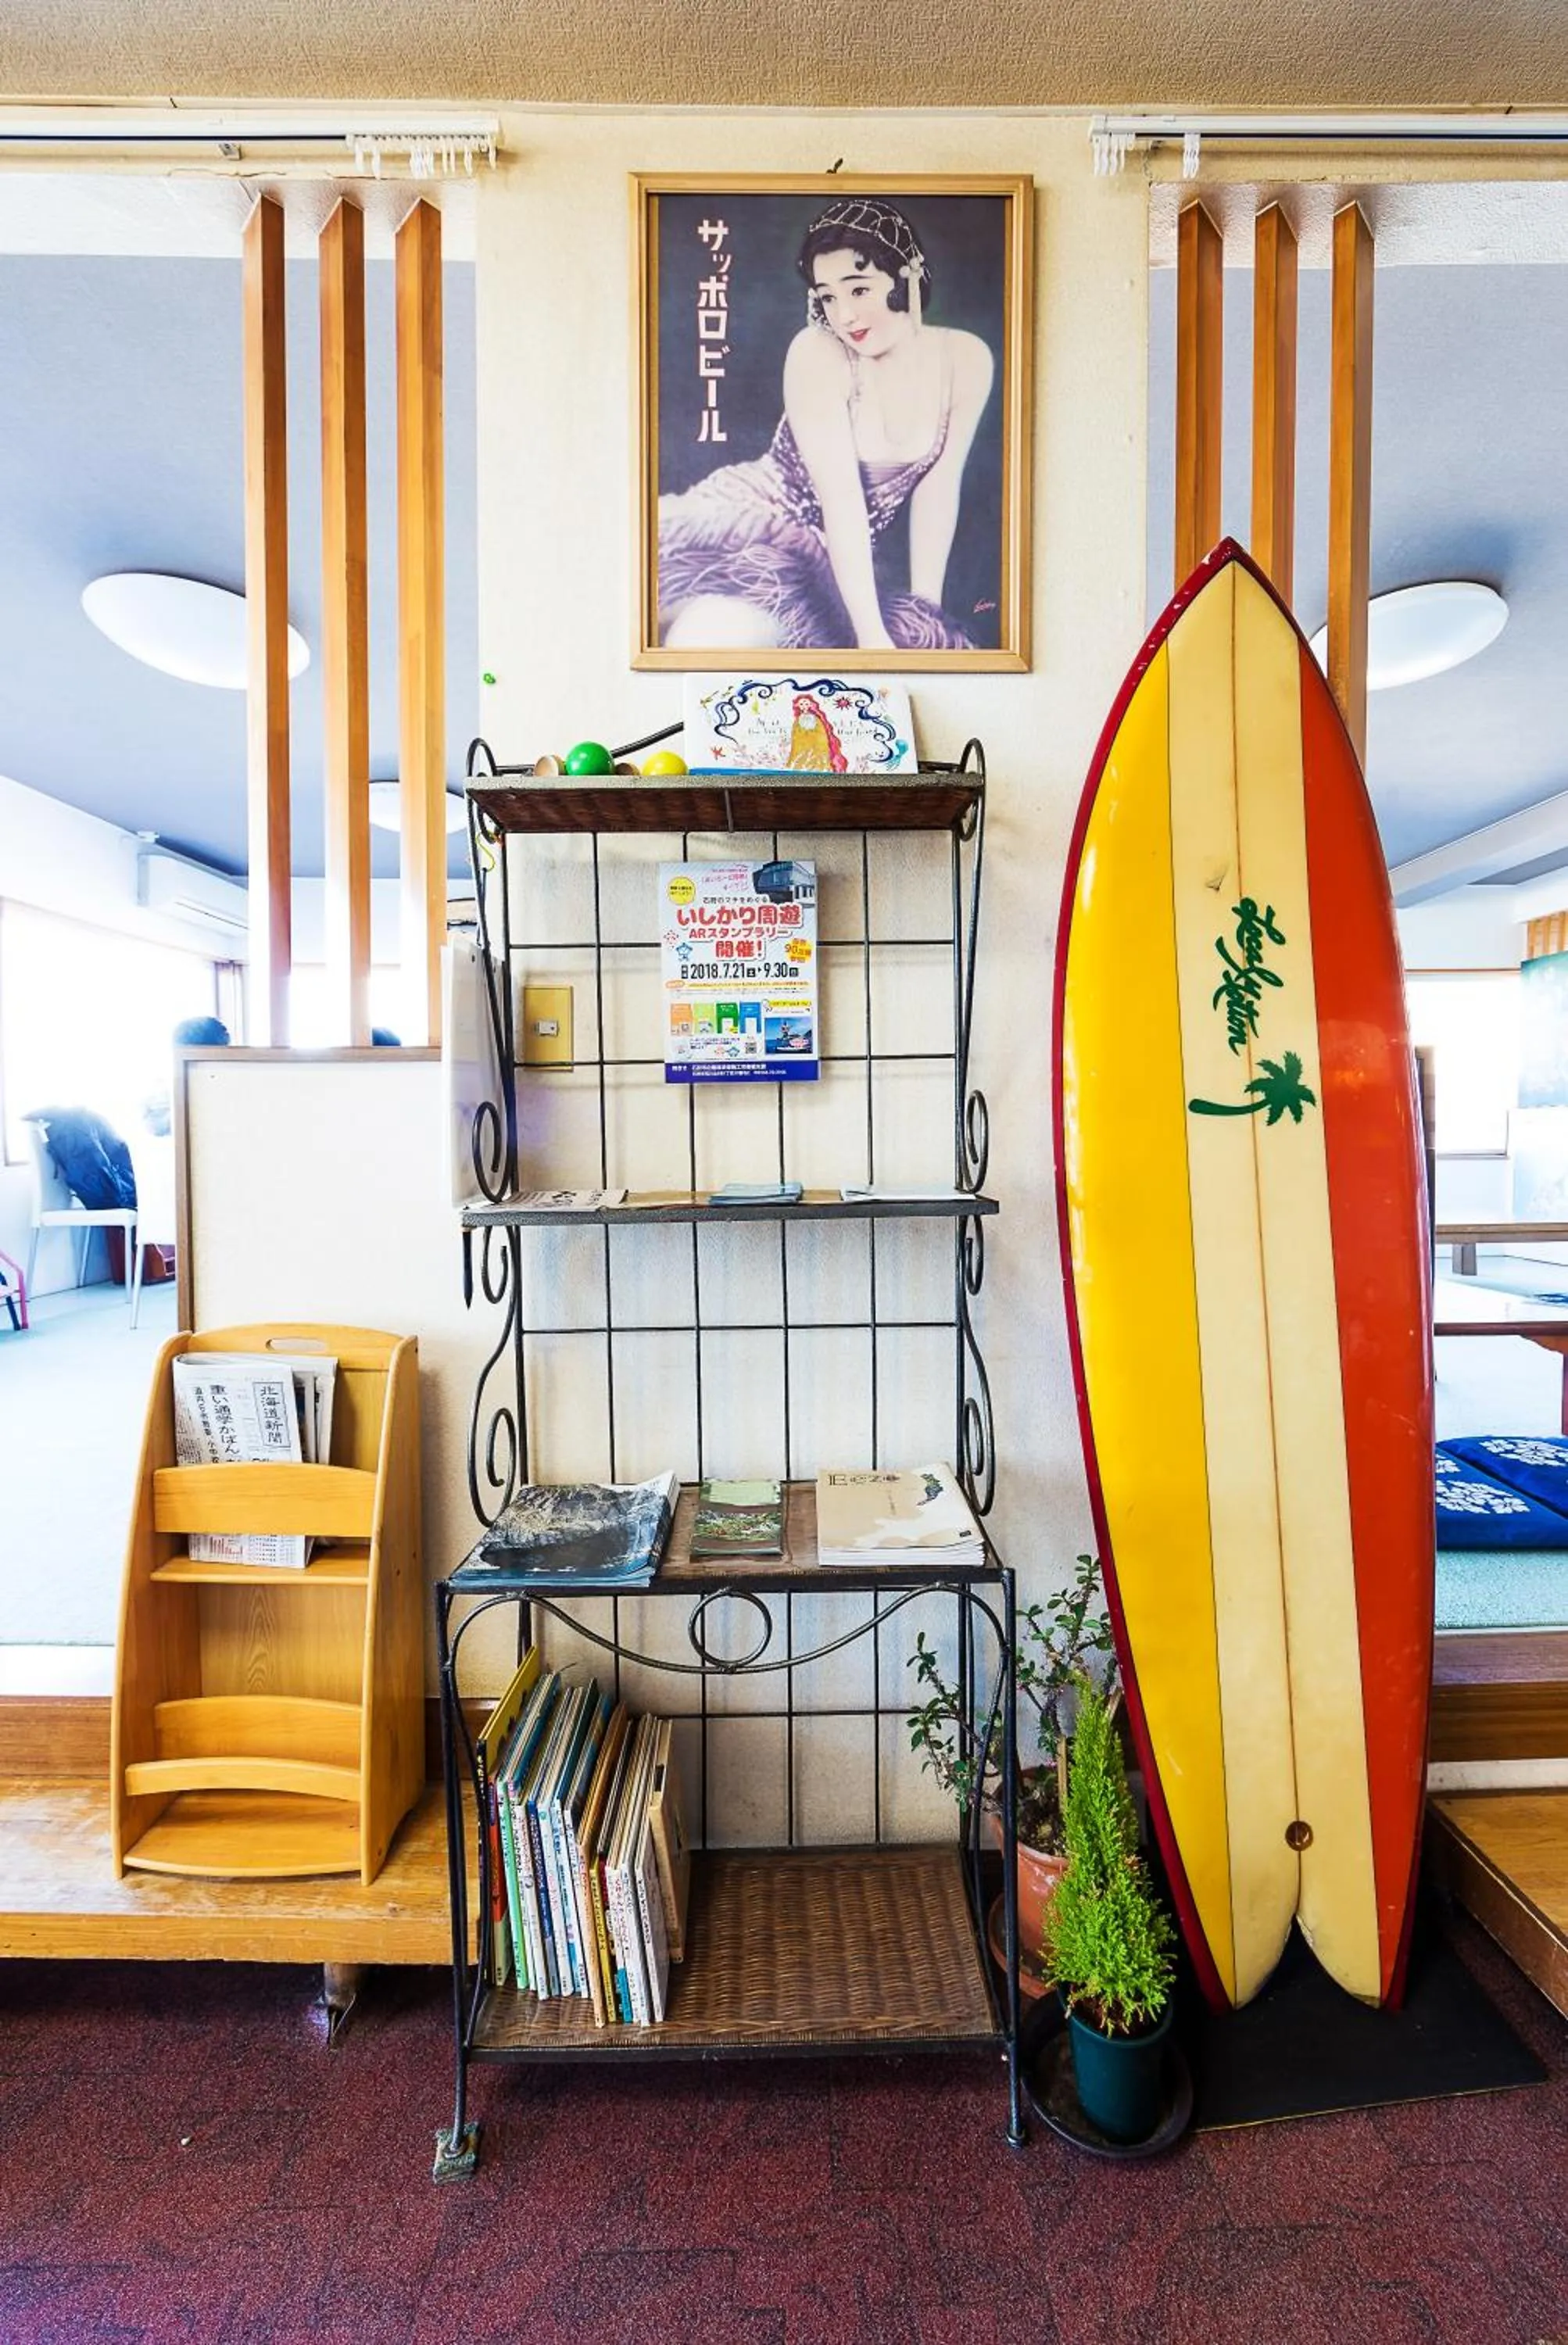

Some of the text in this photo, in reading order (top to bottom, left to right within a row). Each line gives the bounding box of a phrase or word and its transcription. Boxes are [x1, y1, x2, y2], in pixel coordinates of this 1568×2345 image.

[697, 220, 732, 442] サッポロビール
[677, 904, 802, 926] いしかり周遊
[689, 928, 790, 939] ARスタンプラリー
[715, 940, 763, 958] 開催!
[1215, 897, 1287, 987] Local
[260, 1386, 283, 1444] 北海道新聞
